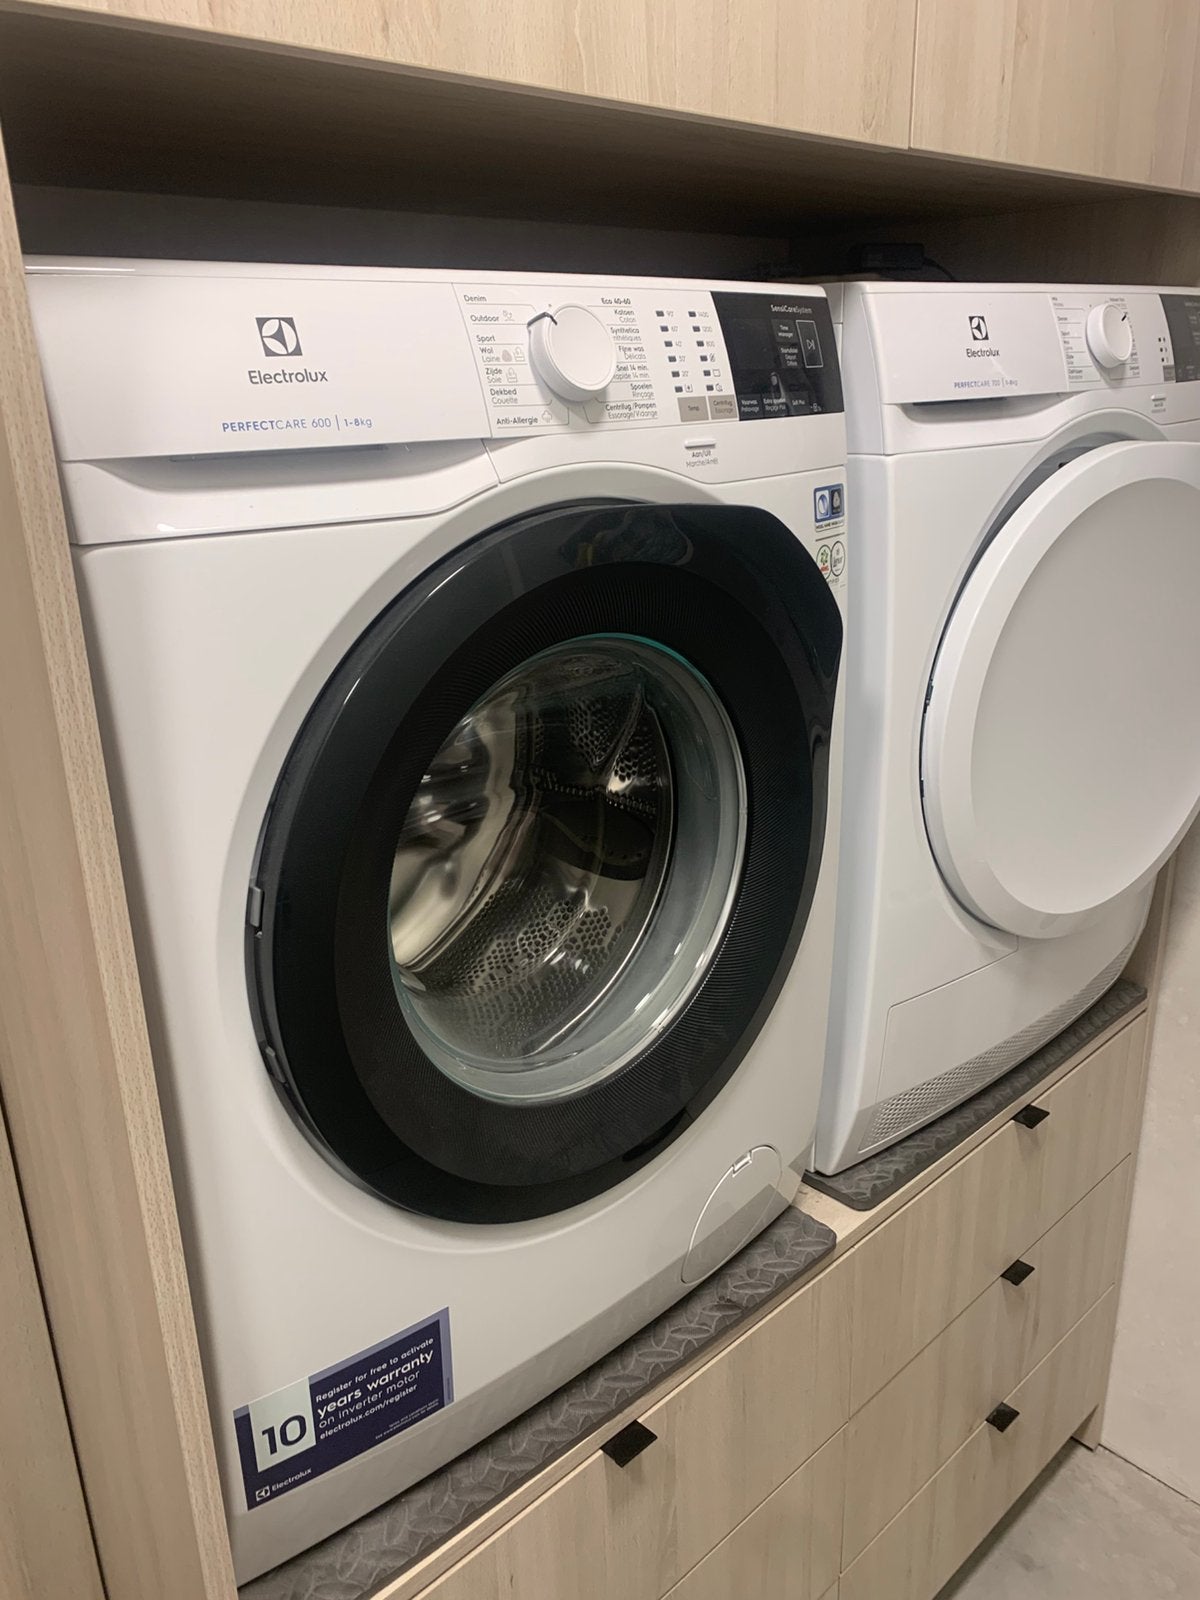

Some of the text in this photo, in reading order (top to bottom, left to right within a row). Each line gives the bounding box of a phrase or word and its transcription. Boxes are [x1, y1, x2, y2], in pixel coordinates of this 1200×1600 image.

[476, 334, 496, 343] Sport
[966, 347, 1000, 358] Electrolux
[616, 364, 629, 372] Snel
[248, 368, 328, 384] Electrolux
[490, 388, 517, 396] Dekbed
[954, 380, 990, 389] PERFECTCARE
[222, 417, 373, 432] PERFECTCARE 600 1-8kg
[496, 418, 538, 426] Anti-Allergie
[316, 1337, 434, 1403] Register for free to activate
[317, 1388, 362, 1419] years
[367, 1350, 434, 1391] warranty
[319, 1416, 335, 1428] on
[338, 1391, 383, 1418] inverter
[386, 1370, 420, 1394] motor
[320, 1384, 418, 1440] electrolux.com/register
[262, 1414, 307, 1455] 10
[272, 1468, 312, 1491] Electrolux
